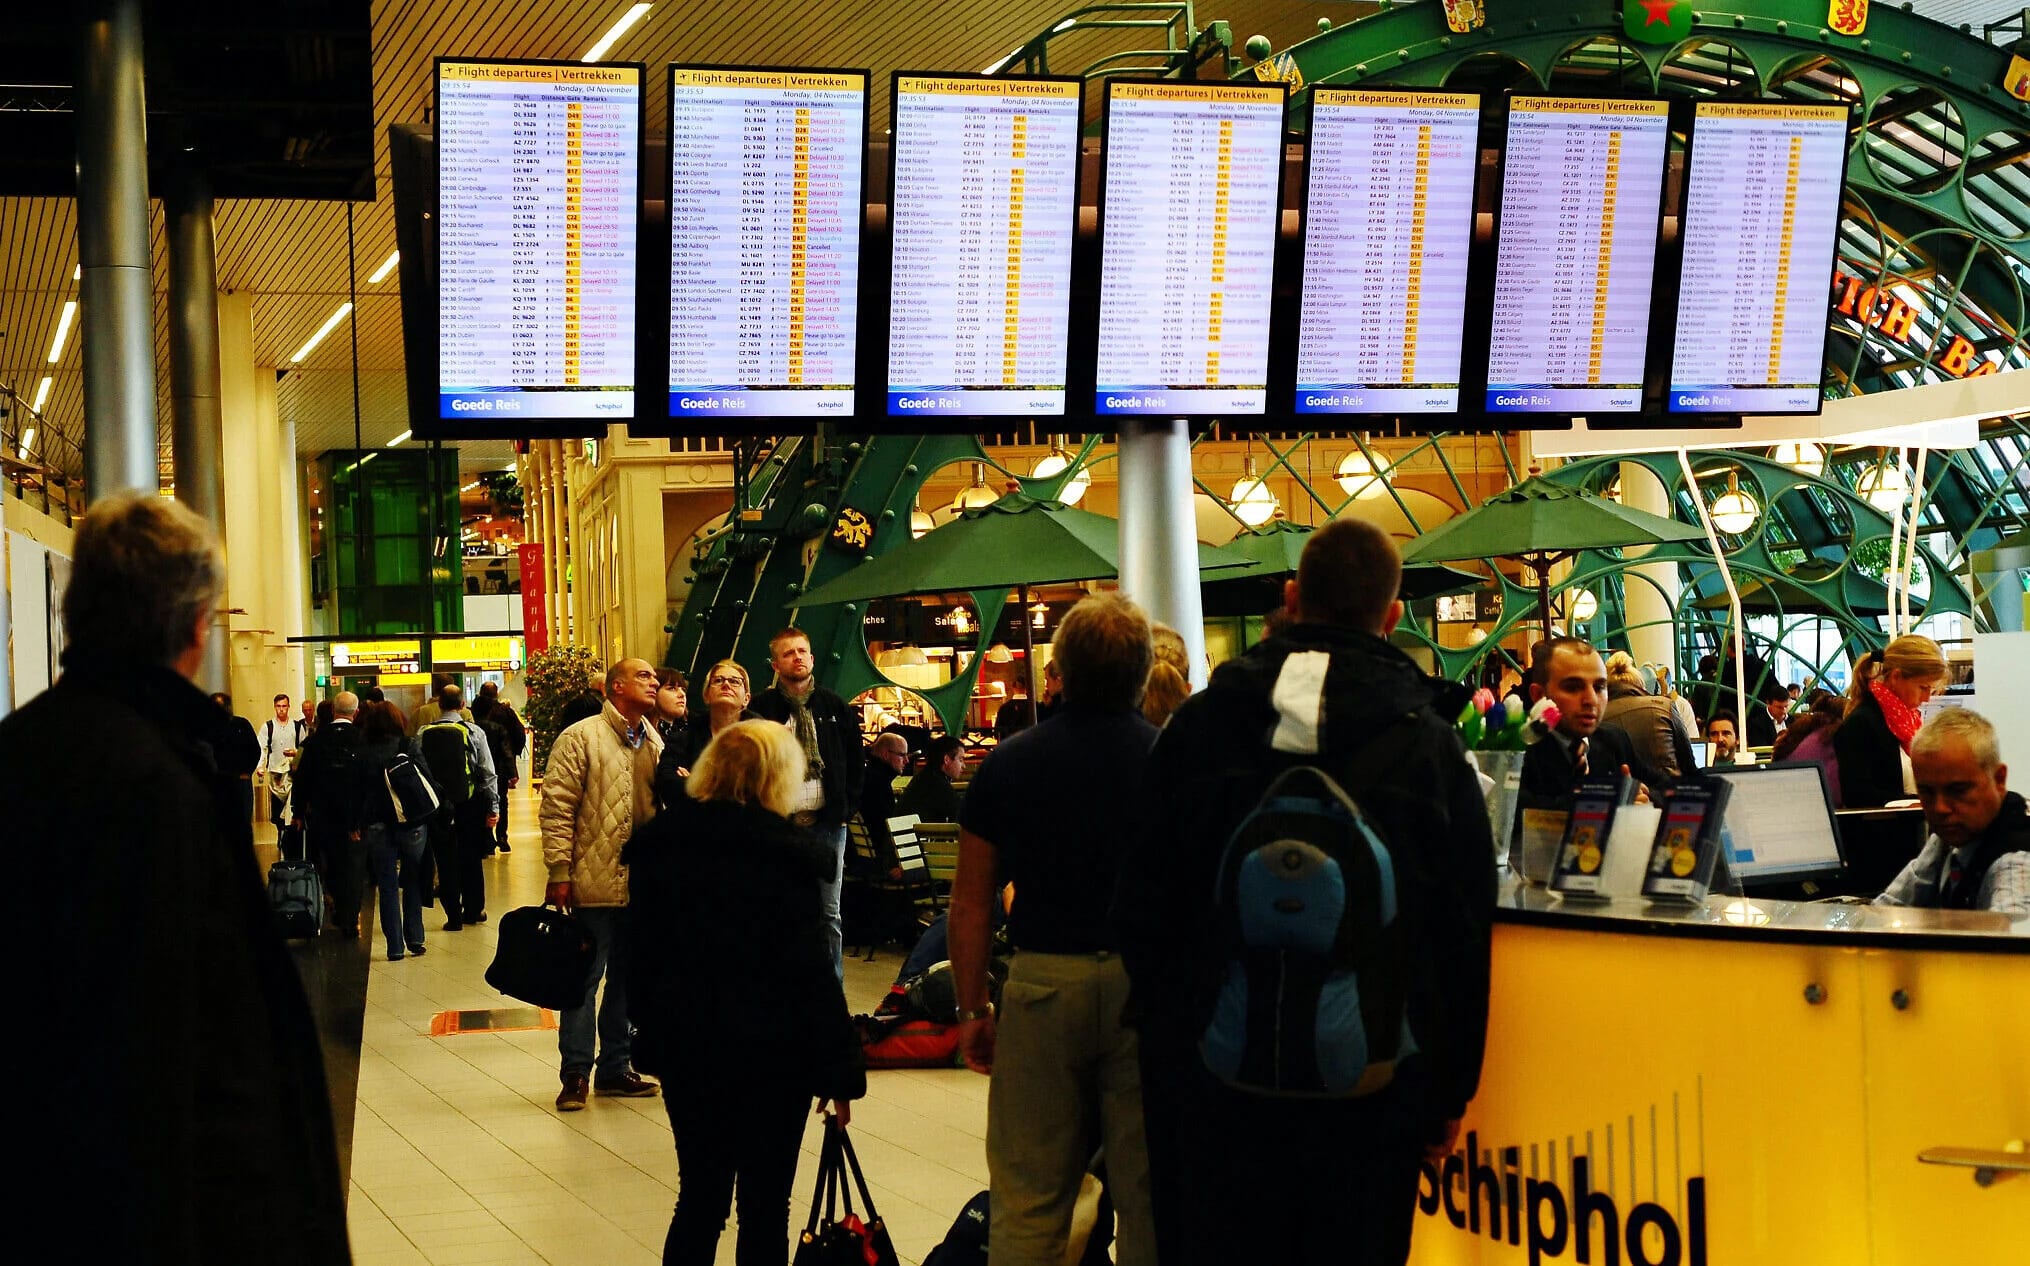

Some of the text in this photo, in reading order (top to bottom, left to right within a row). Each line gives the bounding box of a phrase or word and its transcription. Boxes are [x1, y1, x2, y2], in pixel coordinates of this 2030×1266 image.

[459, 67, 620, 80] Flight departures Vertrekken
[692, 73, 847, 86] Flight departures Vertrekken
[554, 85, 583, 93] Monday,
[916, 80, 1063, 93] Flight departures Vertrekken
[783, 91, 812, 99] Monday,
[1127, 87, 1268, 99] Flight departures Vertrekken
[1002, 98, 1030, 106] Monday,
[1330, 93, 1465, 105] Flight departures Vertrekken
[1525, 99, 1655, 111] Flight departures Vertrekken
[1409, 109, 1434, 117] Monday,
[1710, 106, 1835, 117] Flight departures Vertrekken
[452, 400, 520, 411] Goede Reis
[681, 398, 746, 409] Goede Reis
[817, 401, 843, 409] Schiphol
[899, 398, 961, 409] Goede Reis
[1029, 401, 1054, 409] Schiphol
[1106, 397, 1166, 408] Goede Reis
[1306, 396, 1363, 406] Goede Reis
[1496, 396, 1551, 406] Goede Reis
[1679, 396, 1732, 406] Goede Reis
[526, 550, 539, 633] Grand
